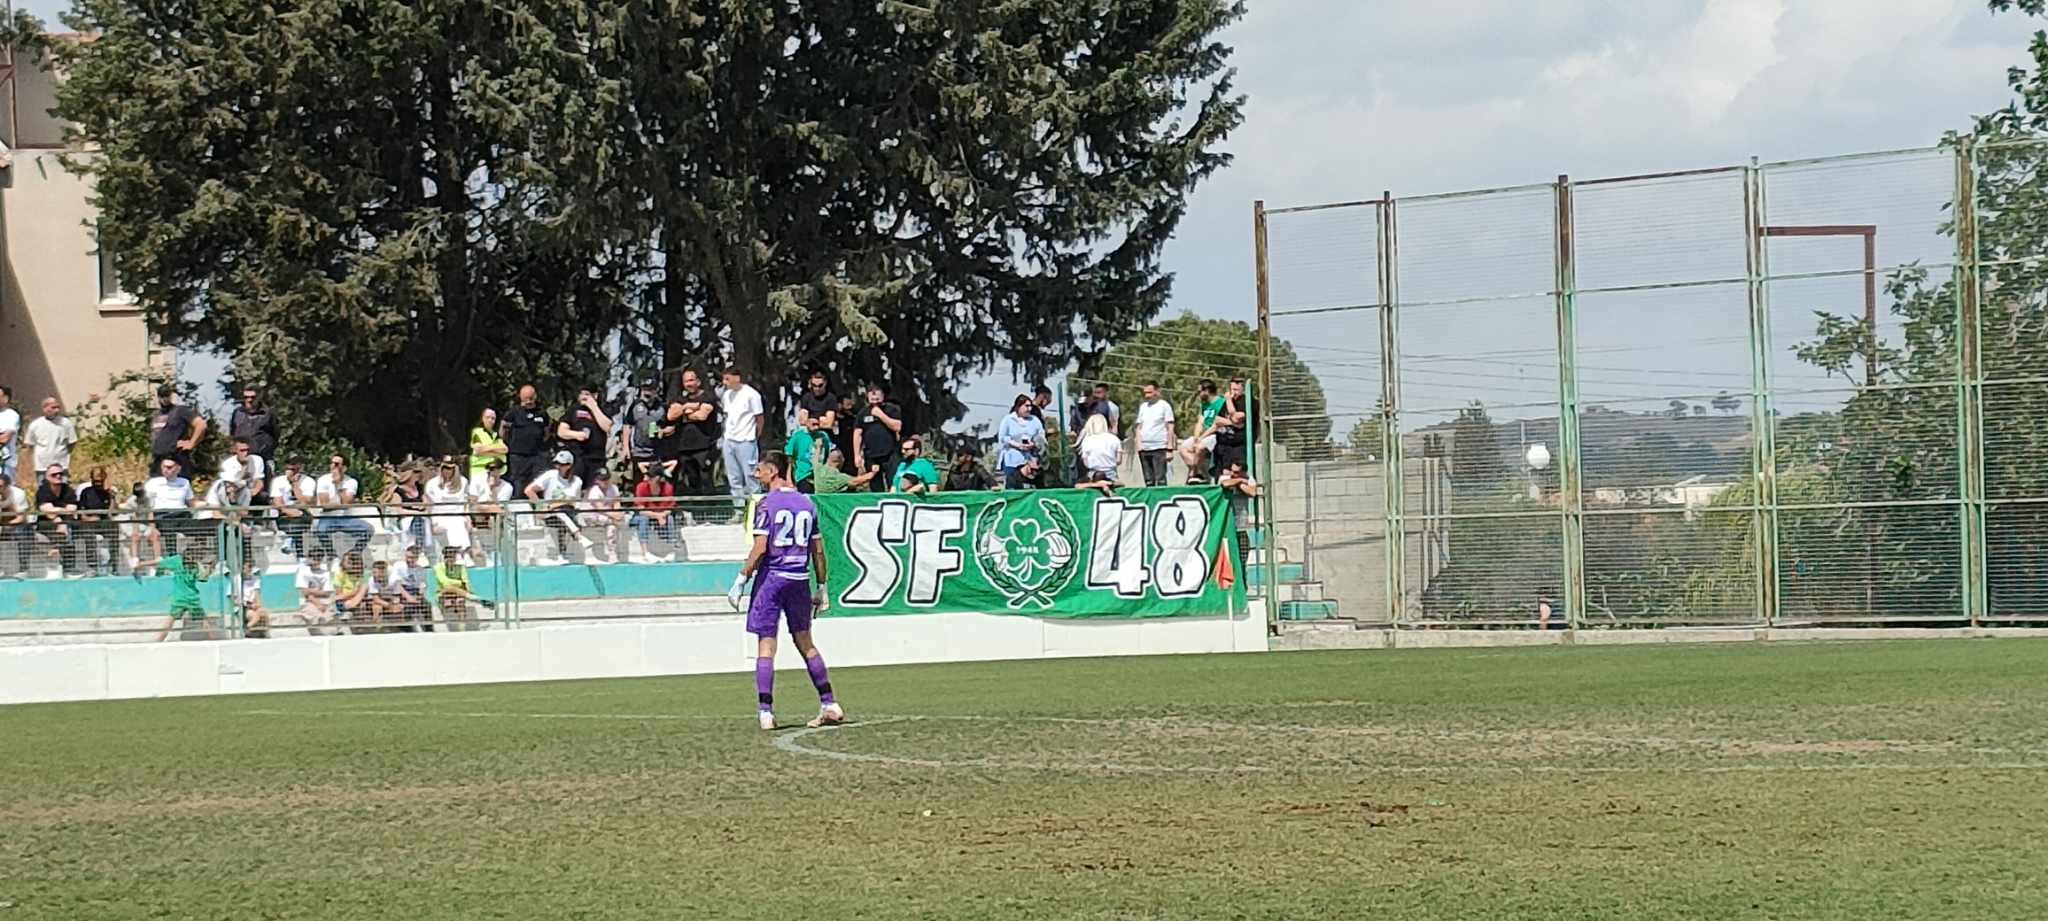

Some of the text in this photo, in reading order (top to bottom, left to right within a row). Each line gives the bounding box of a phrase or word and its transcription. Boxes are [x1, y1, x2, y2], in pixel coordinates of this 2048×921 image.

[774, 509, 813, 547] 20
[840, 496, 1209, 606] SF 48
